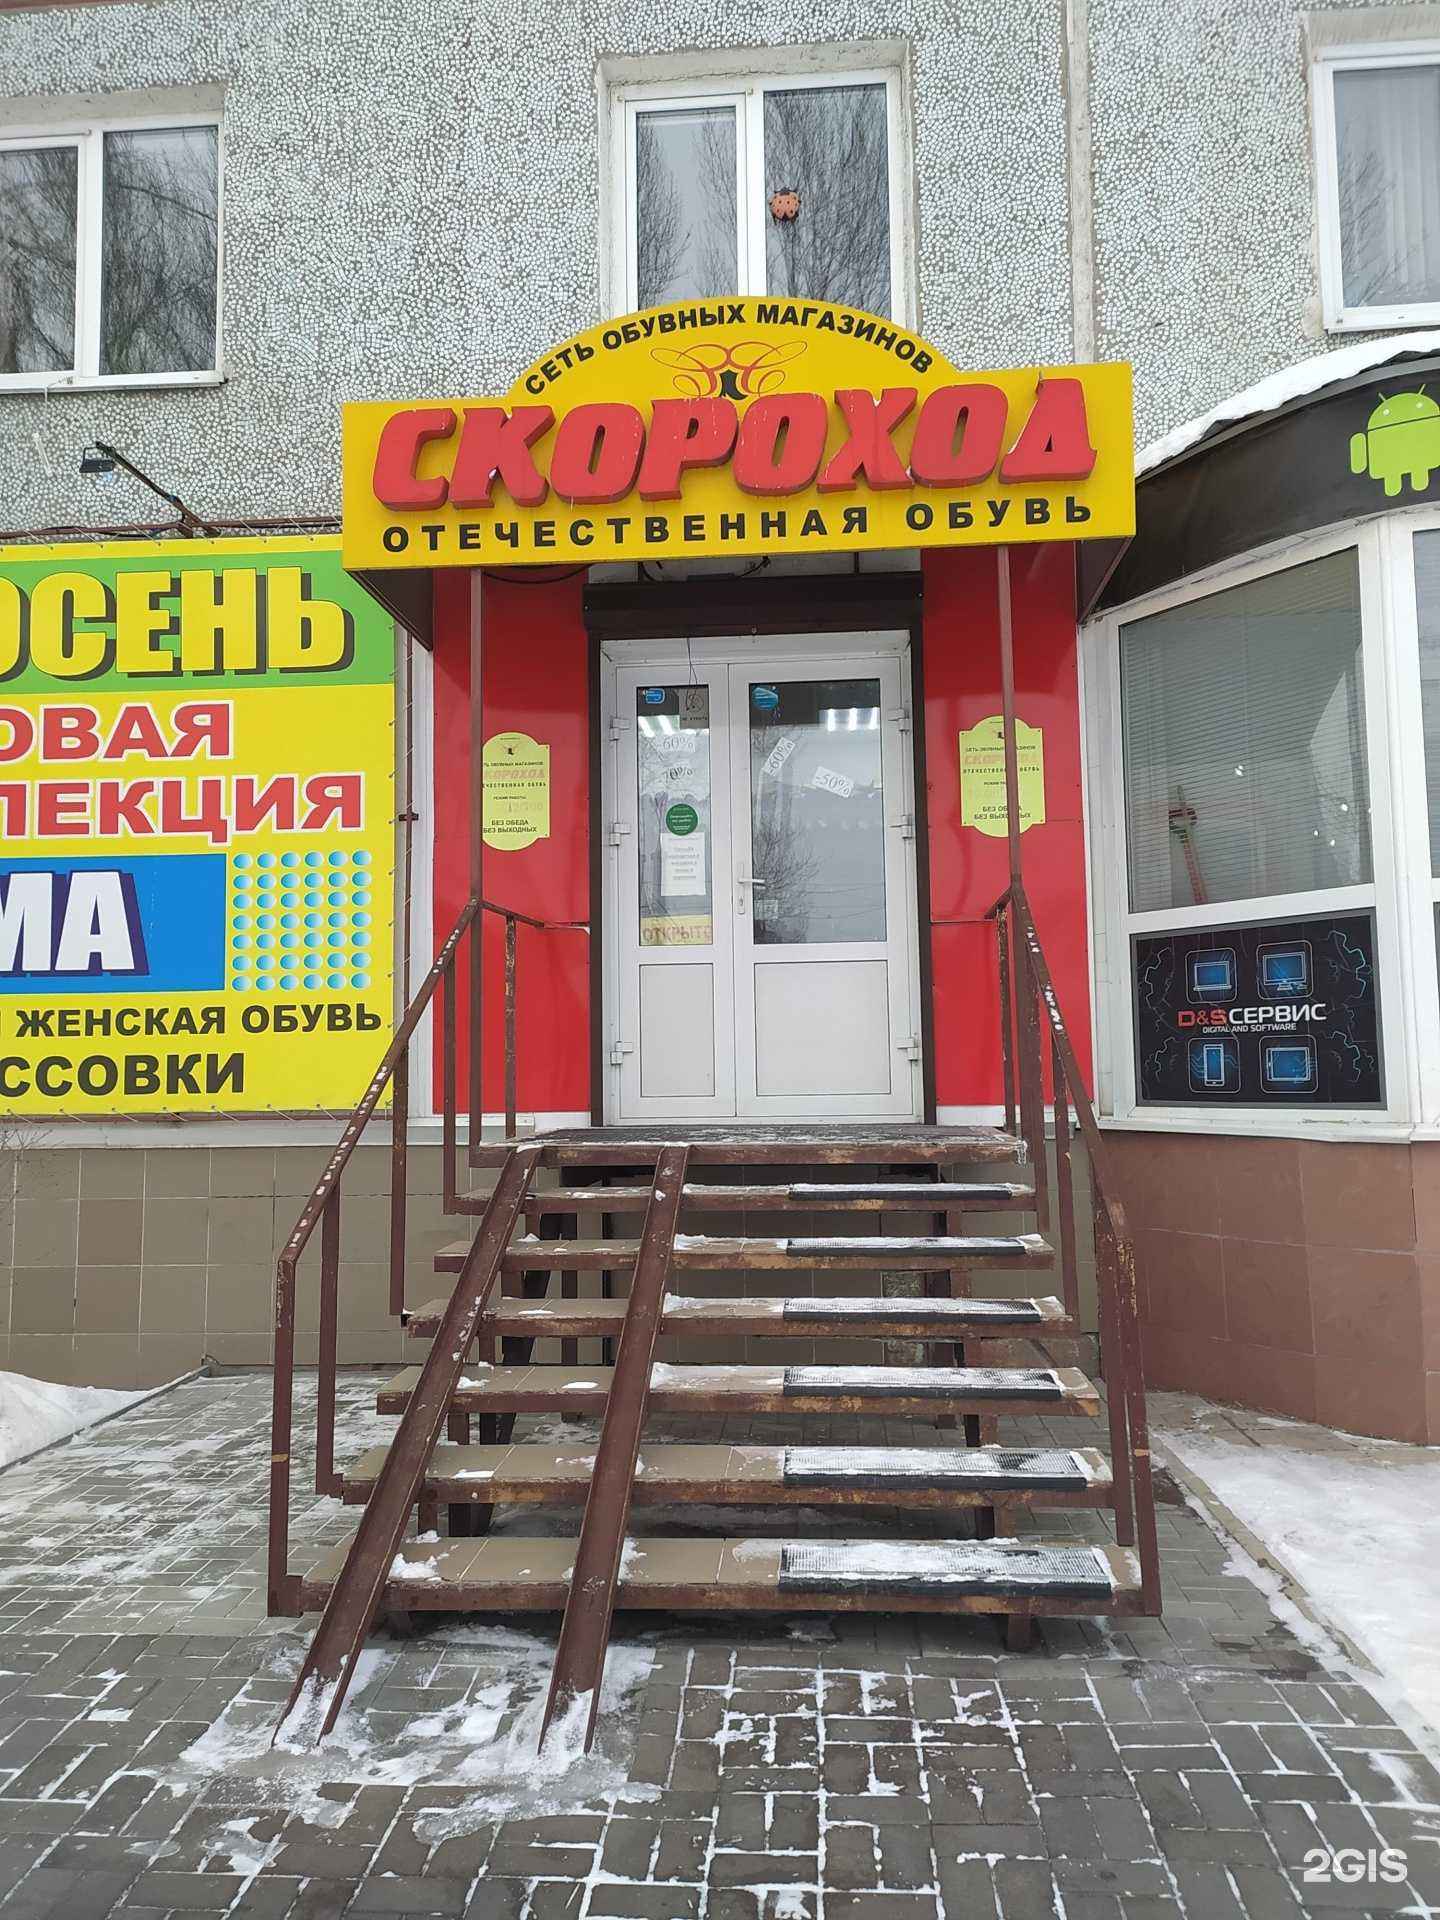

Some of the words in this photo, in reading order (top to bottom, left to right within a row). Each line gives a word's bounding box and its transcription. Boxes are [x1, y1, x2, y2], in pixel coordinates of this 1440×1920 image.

[525, 343, 595, 395] СЕТЬ
[602, 303, 747, 350] ОБУВНЫХ
[756, 304, 933, 374] МАГАЗИНОВ
[372, 378, 1098, 512] СКОРОХОД
[383, 506, 867, 553] ОТЕЧЕСТВЕННАЯ
[905, 496, 1091, 531] ОБУВЬ
[0, 566, 350, 679] СЕНЬ
[497, 826, 537, 834] ВЫХОДНЫХ
[16, 1006, 226, 1037] ЖЕНСКАЯ
[241, 1003, 382, 1034] ОБУВЬ
[1202, 1025, 1231, 1034] DIGITAL
[1231, 1024, 1248, 1033] AND
[1250, 1022, 1297, 1033] SOFTWARE
[0, 1052, 245, 1098] ССОВКИ
